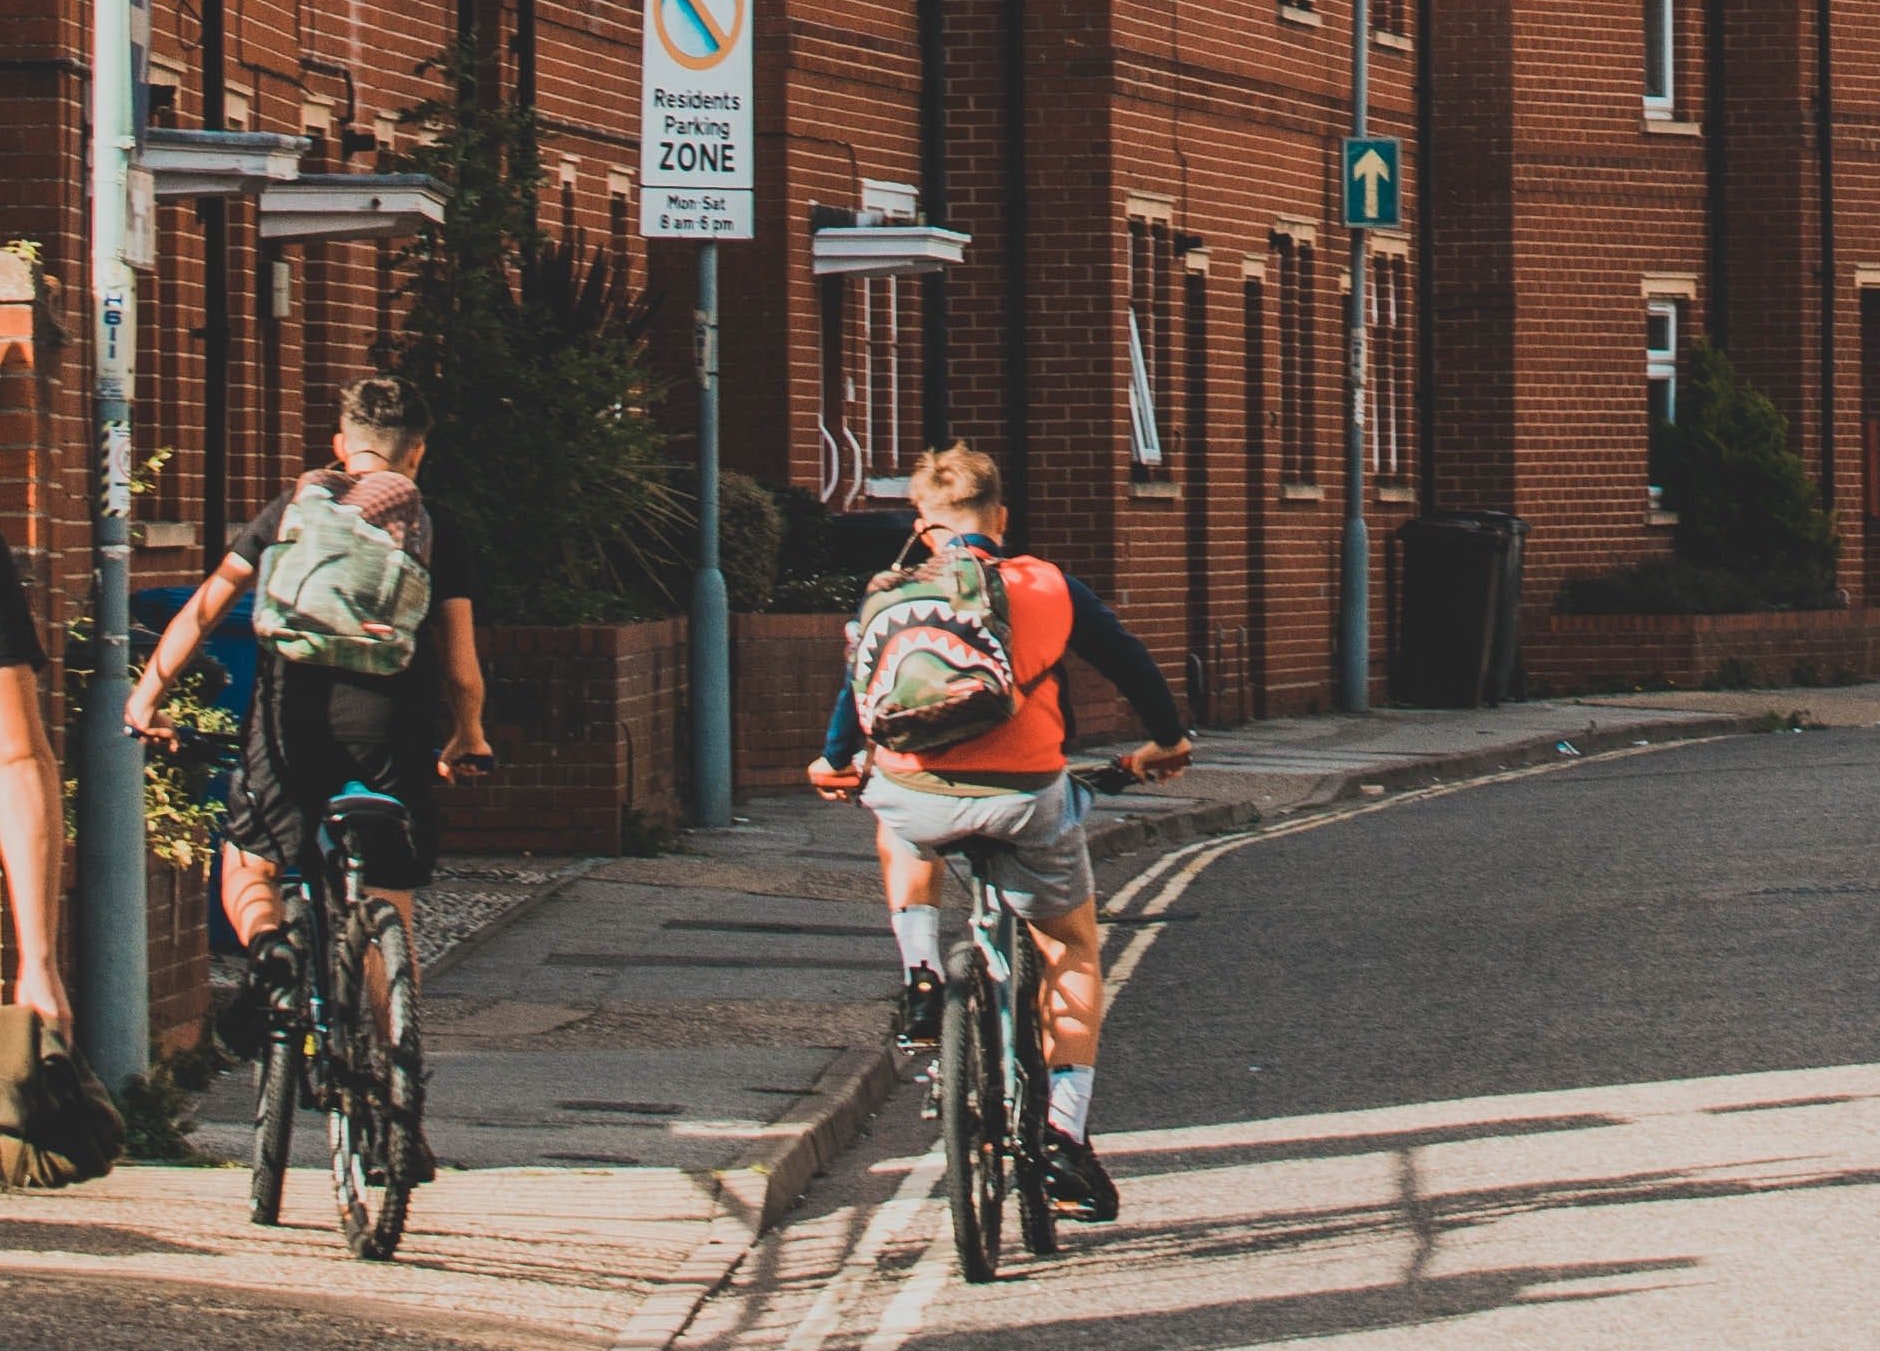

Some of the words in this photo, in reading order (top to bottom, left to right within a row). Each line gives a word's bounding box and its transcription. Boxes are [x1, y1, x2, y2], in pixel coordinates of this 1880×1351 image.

[654, 88, 741, 110] Residents
[664, 115, 730, 139] Parking
[659, 141, 735, 172] ZONE
[713, 219, 734, 232] pm
